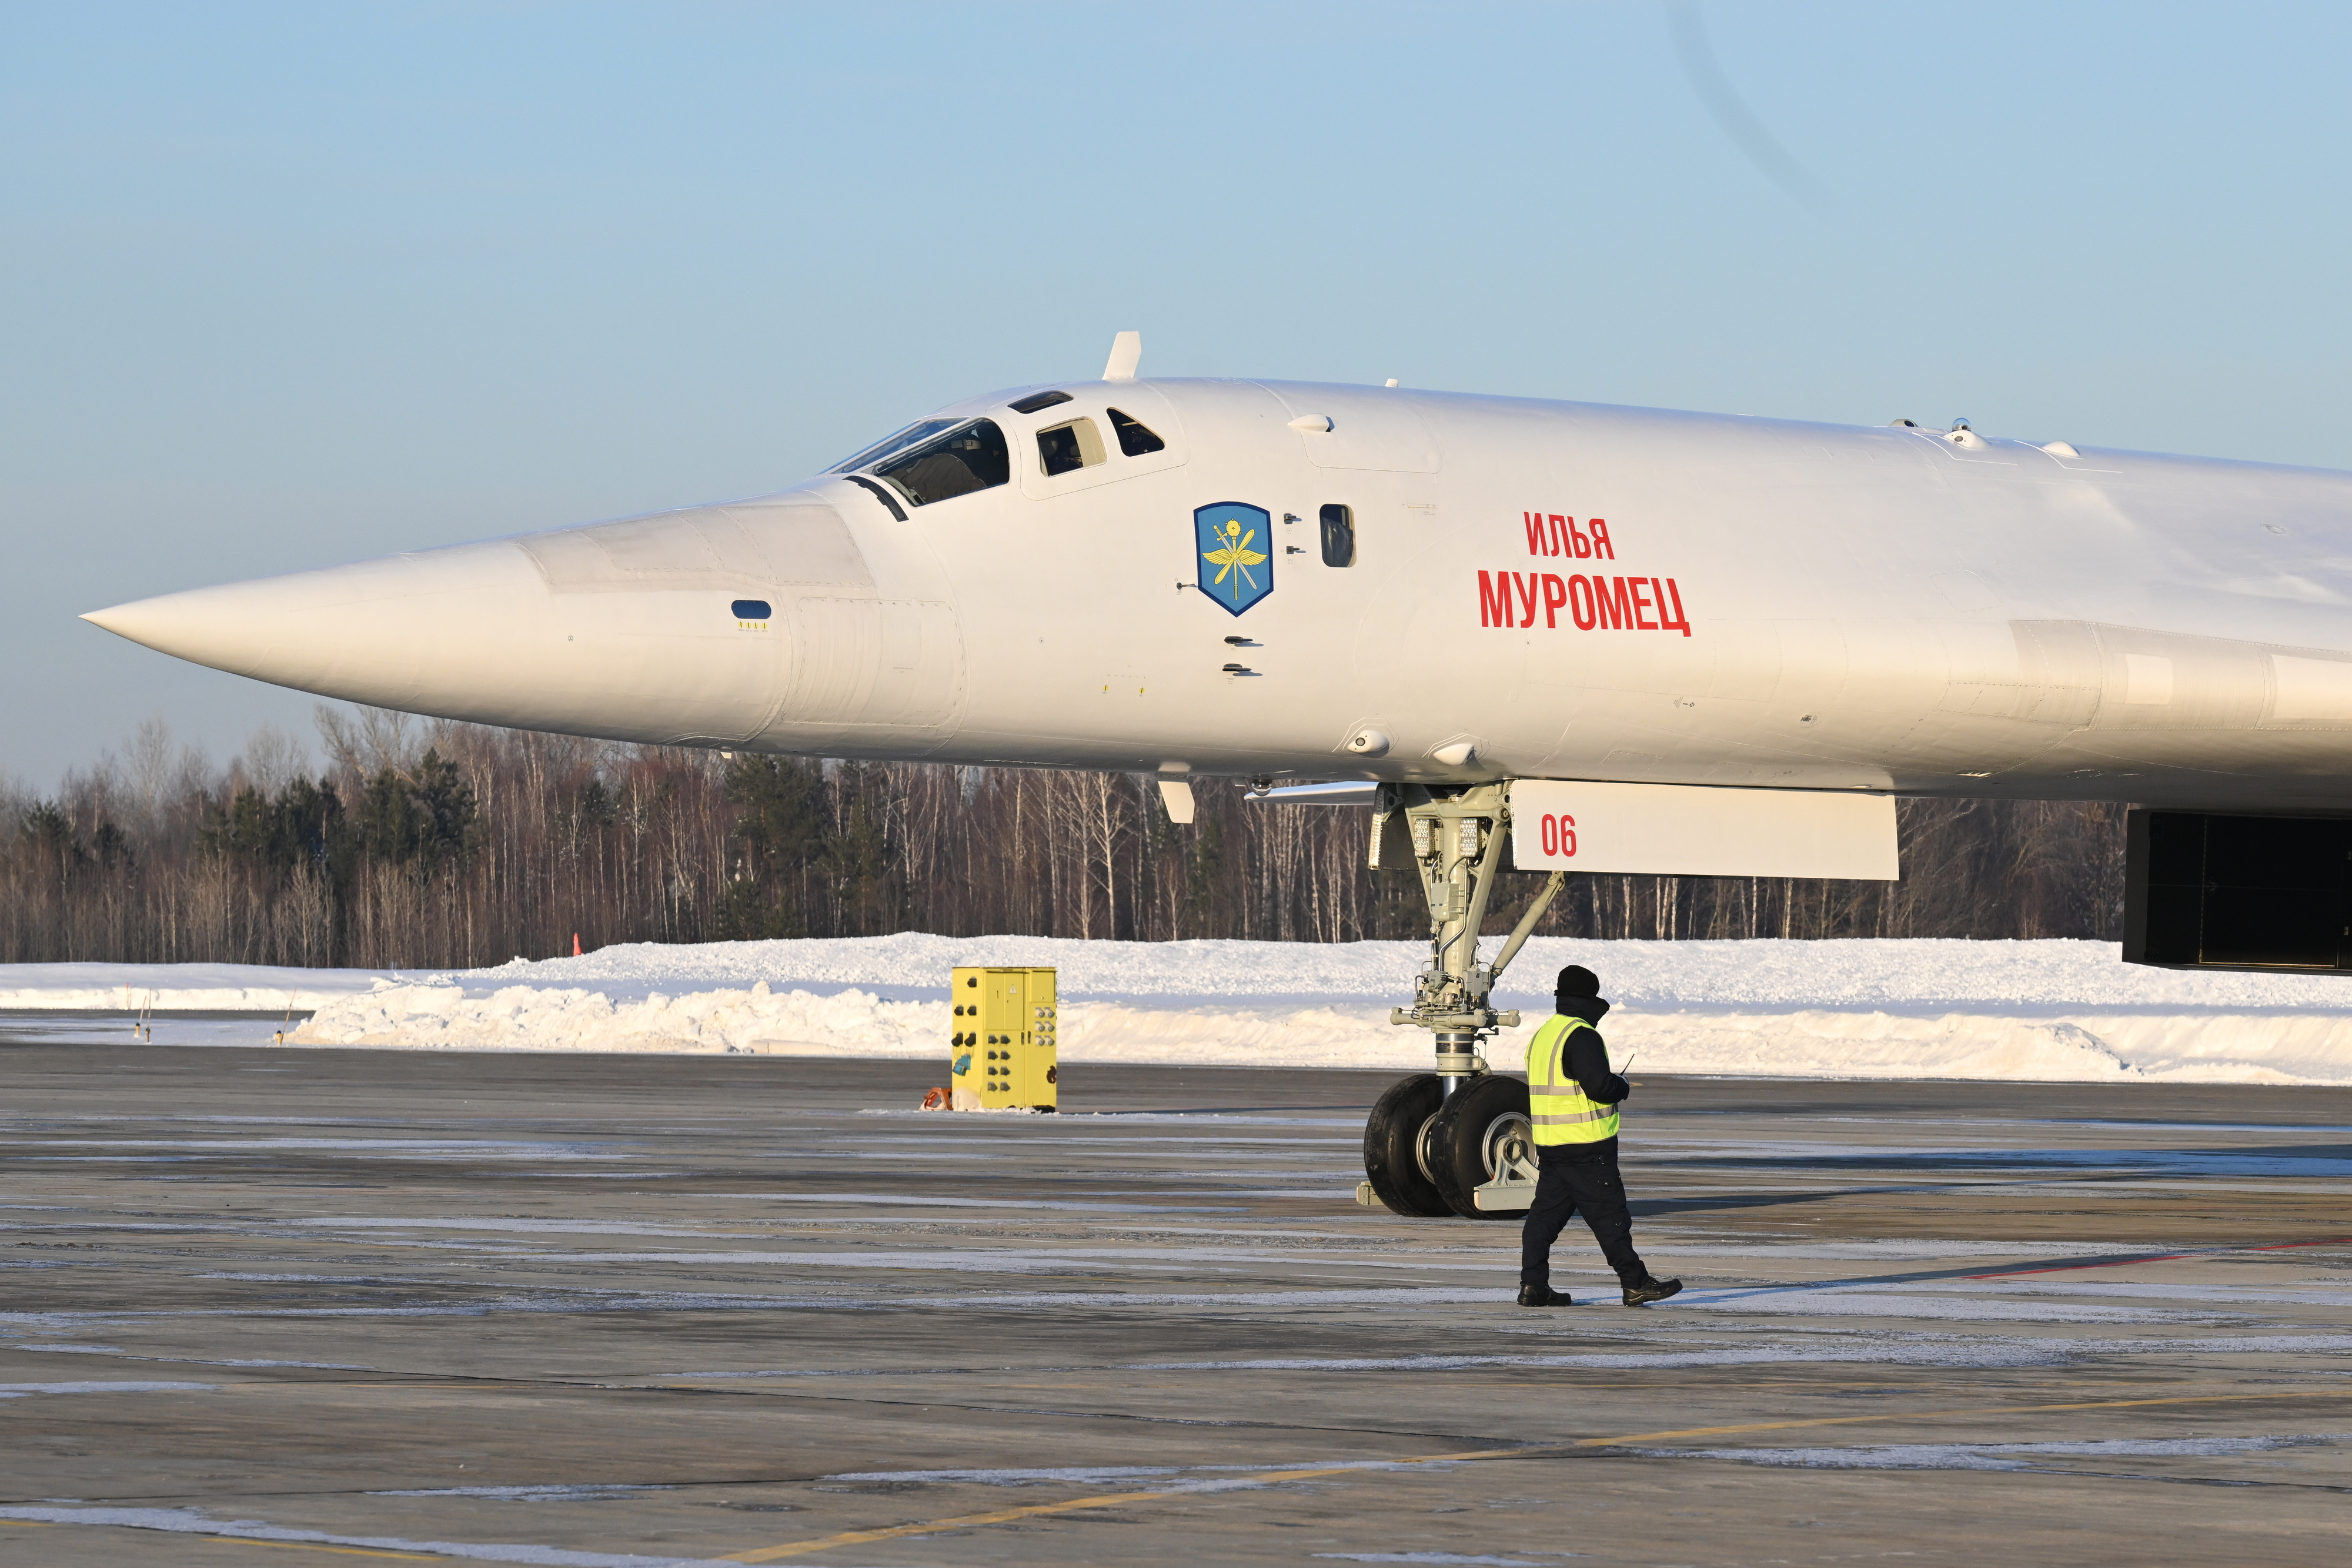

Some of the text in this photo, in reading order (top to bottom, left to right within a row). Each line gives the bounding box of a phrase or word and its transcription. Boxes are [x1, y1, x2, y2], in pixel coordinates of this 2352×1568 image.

[1524, 511, 1615, 560] ИЛЬЯ
[1478, 570, 1692, 637] МУРОМЕЦ
[1541, 814, 1577, 857] 06
